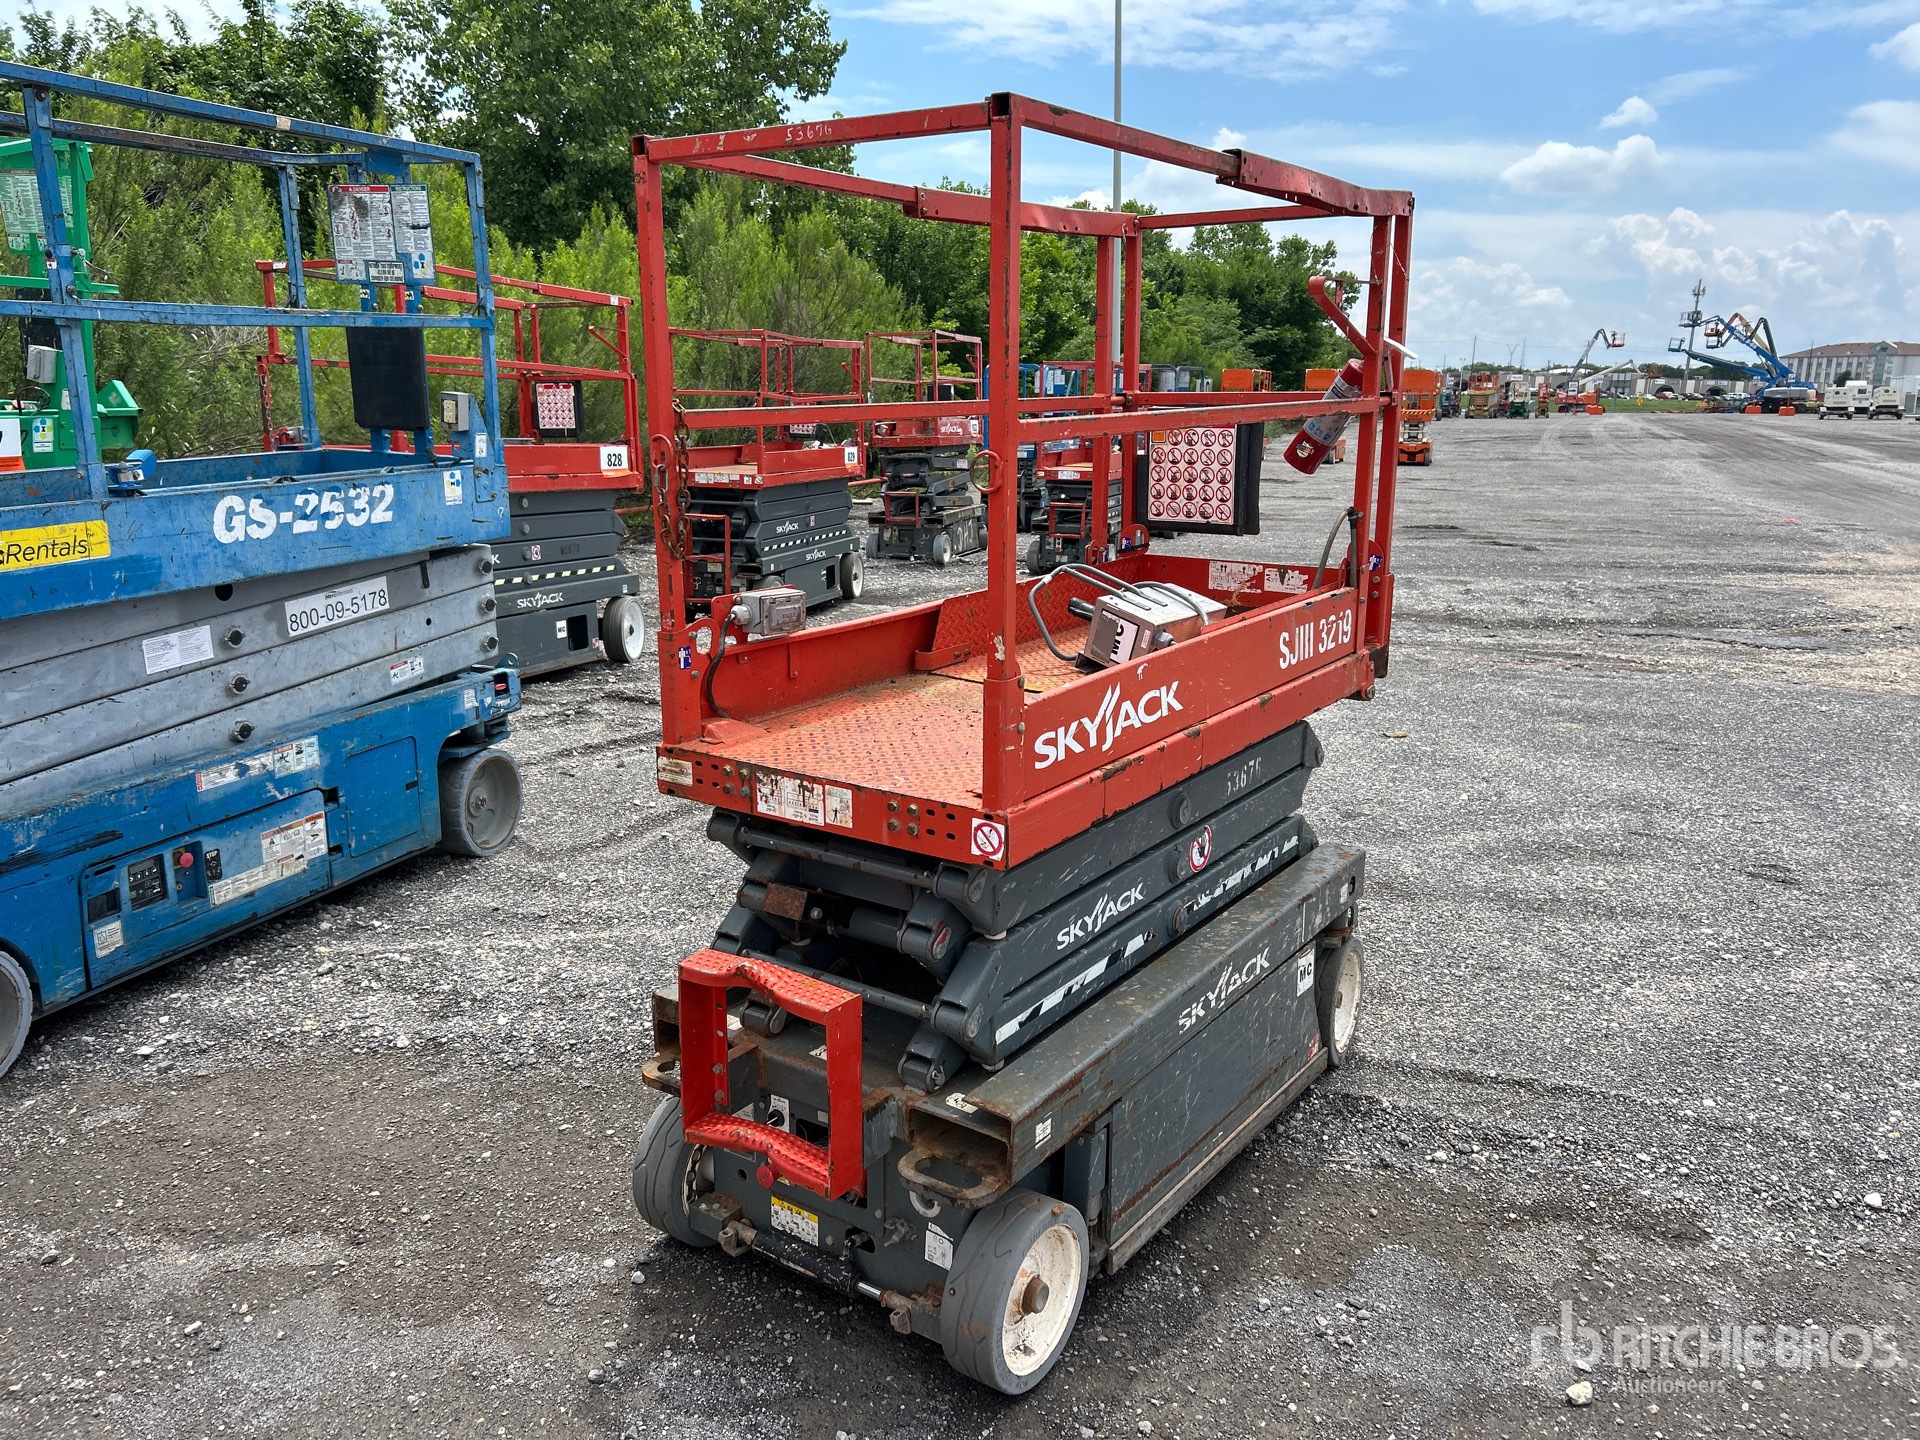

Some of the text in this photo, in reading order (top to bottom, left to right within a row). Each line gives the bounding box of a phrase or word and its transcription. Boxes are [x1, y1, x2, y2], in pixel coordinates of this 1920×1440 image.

[785, 123, 832, 141] 53676
[607, 453, 623, 467] 828
[776, 521, 799, 533] SKYJACK
[289, 589, 388, 632] 800-09-5178
[517, 592, 564, 609] SKYJACK
[1318, 608, 1352, 654] 3219
[1033, 680, 1185, 771] SKYJACK
[1056, 883, 1145, 951] SKYJACK
[1299, 962, 1313, 983] MC
[1178, 946, 1271, 1035] SKYJACK
